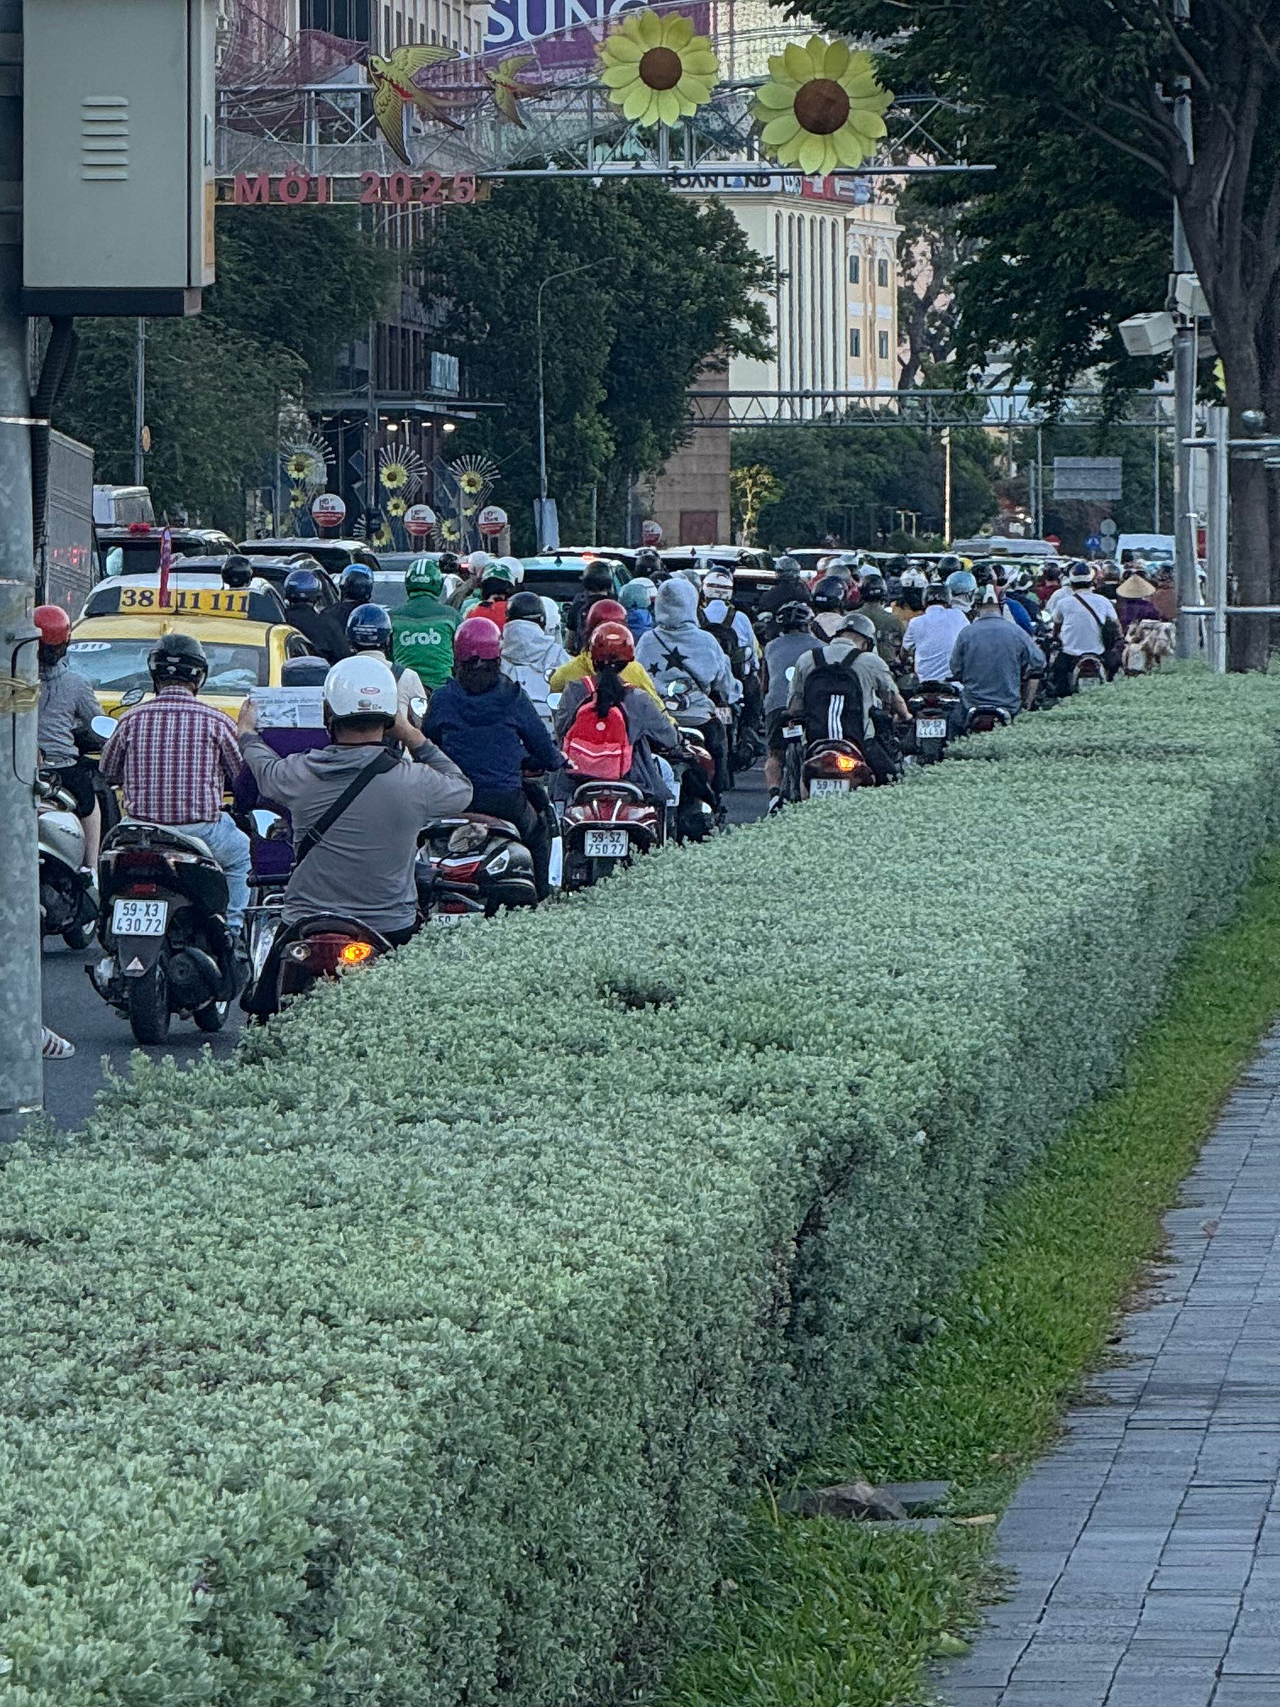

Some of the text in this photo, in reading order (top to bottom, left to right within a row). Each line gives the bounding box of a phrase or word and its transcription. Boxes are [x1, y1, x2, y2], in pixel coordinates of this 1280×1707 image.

[359, 171, 474, 204] 2025
[410, 575, 431, 583] Grab
[122, 588, 154, 607] 38
[210, 593, 249, 612] 111
[399, 628, 441, 645] Grab
[122, 902, 159, 917] 59-X3
